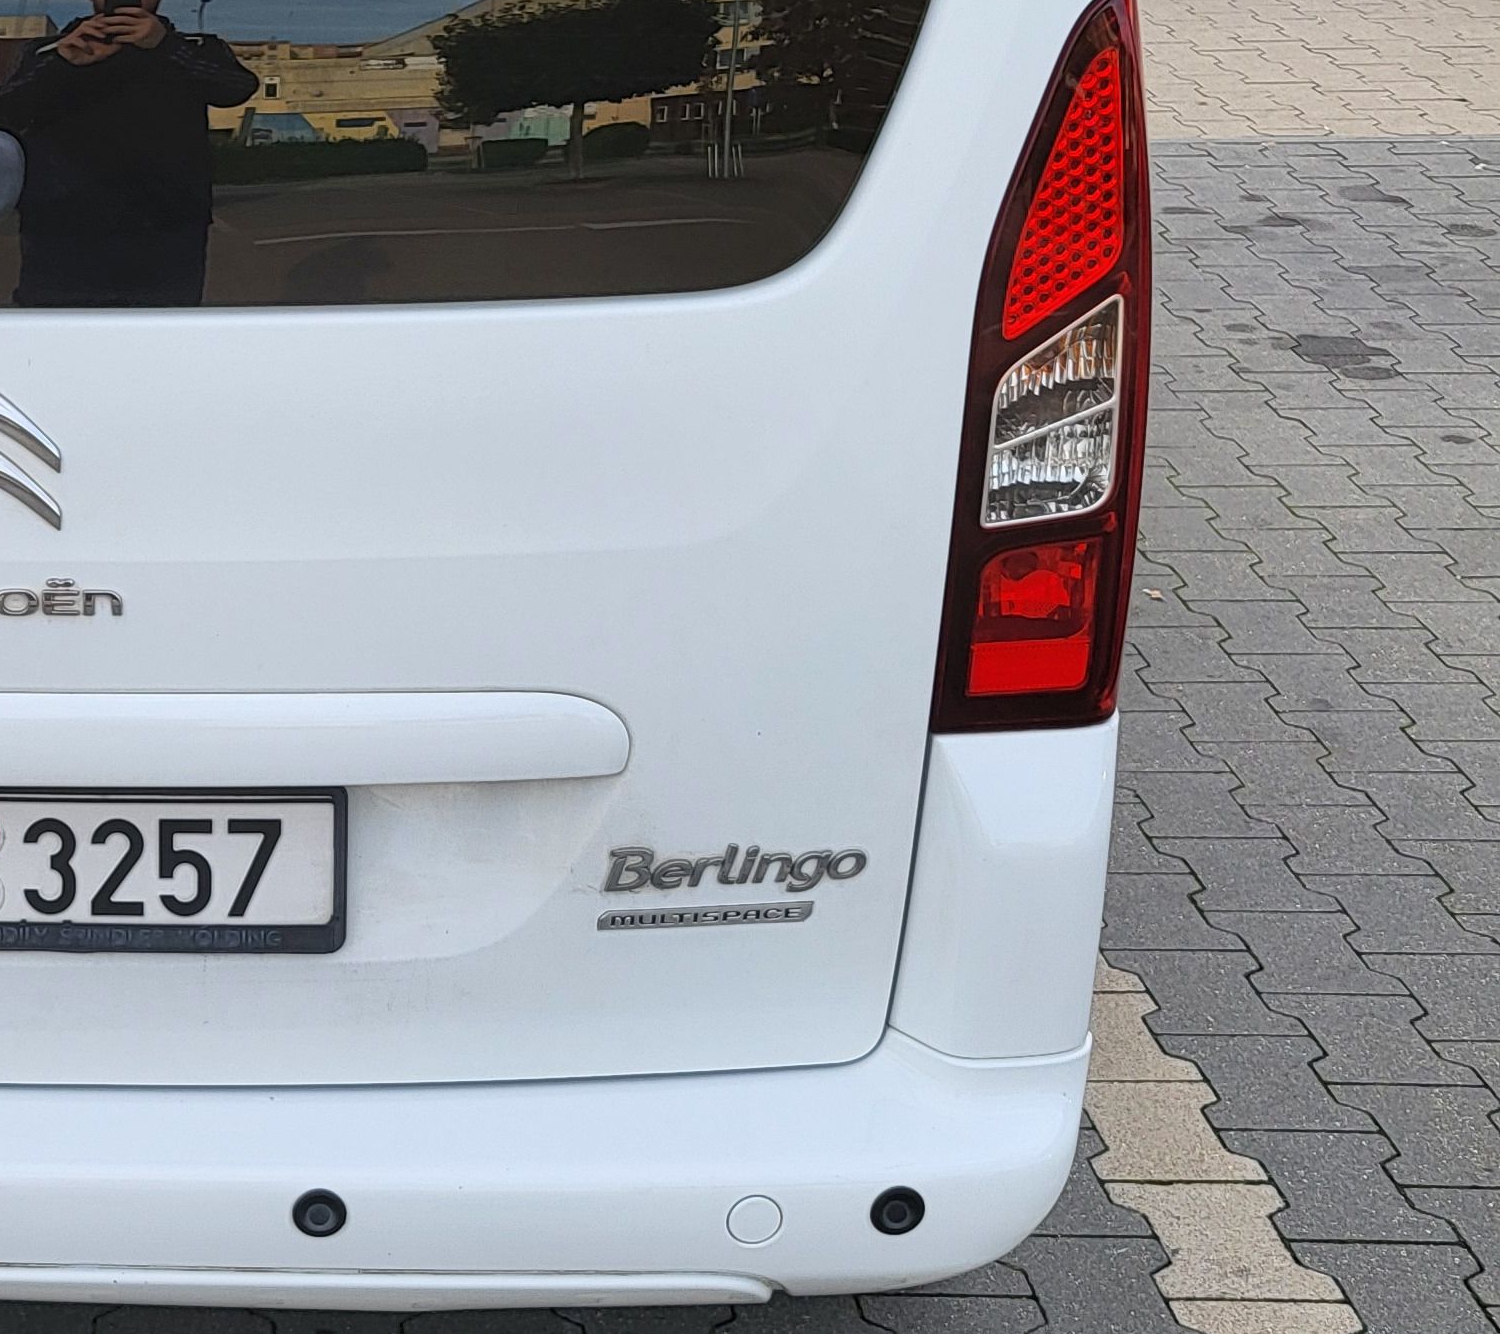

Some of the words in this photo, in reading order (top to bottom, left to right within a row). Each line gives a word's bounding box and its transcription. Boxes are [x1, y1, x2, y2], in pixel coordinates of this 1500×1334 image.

[22, 818, 283, 917] 3257
[604, 843, 867, 893] Berlingo
[610, 906, 804, 927] MULTISPACE
